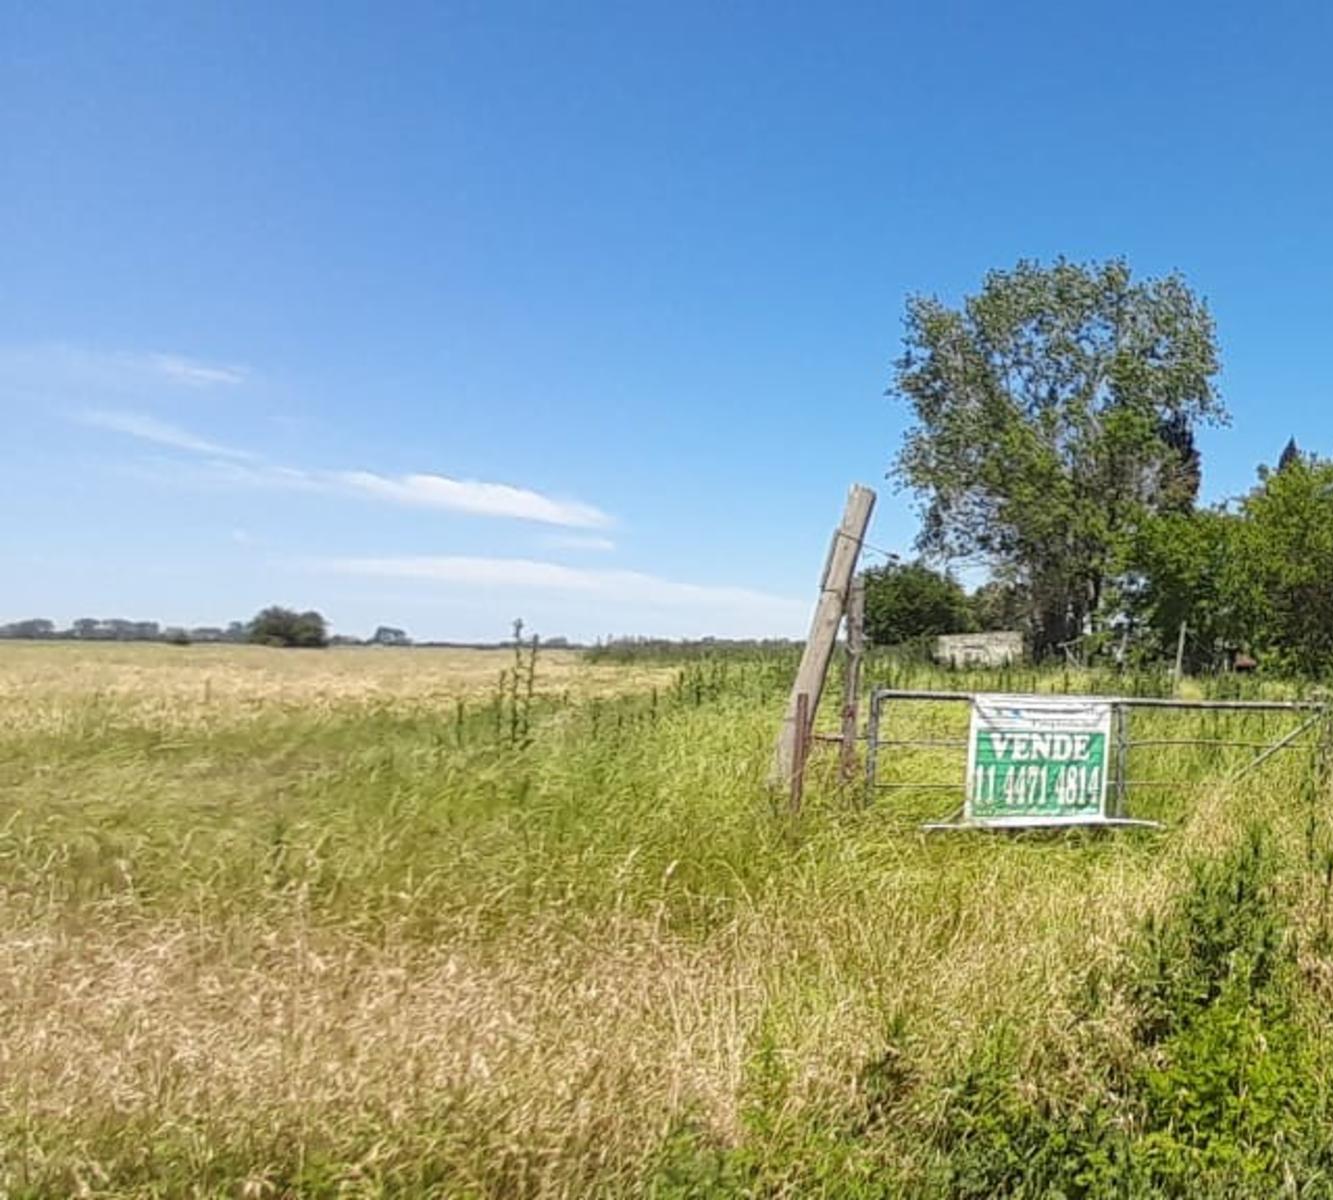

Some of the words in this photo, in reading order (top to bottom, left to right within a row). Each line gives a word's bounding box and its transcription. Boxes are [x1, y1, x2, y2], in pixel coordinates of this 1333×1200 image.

[991, 733, 1090, 761] VENDE
[975, 764, 996, 803] 11
[1003, 764, 1047, 805] 4471
[1055, 764, 1100, 805] 4814
